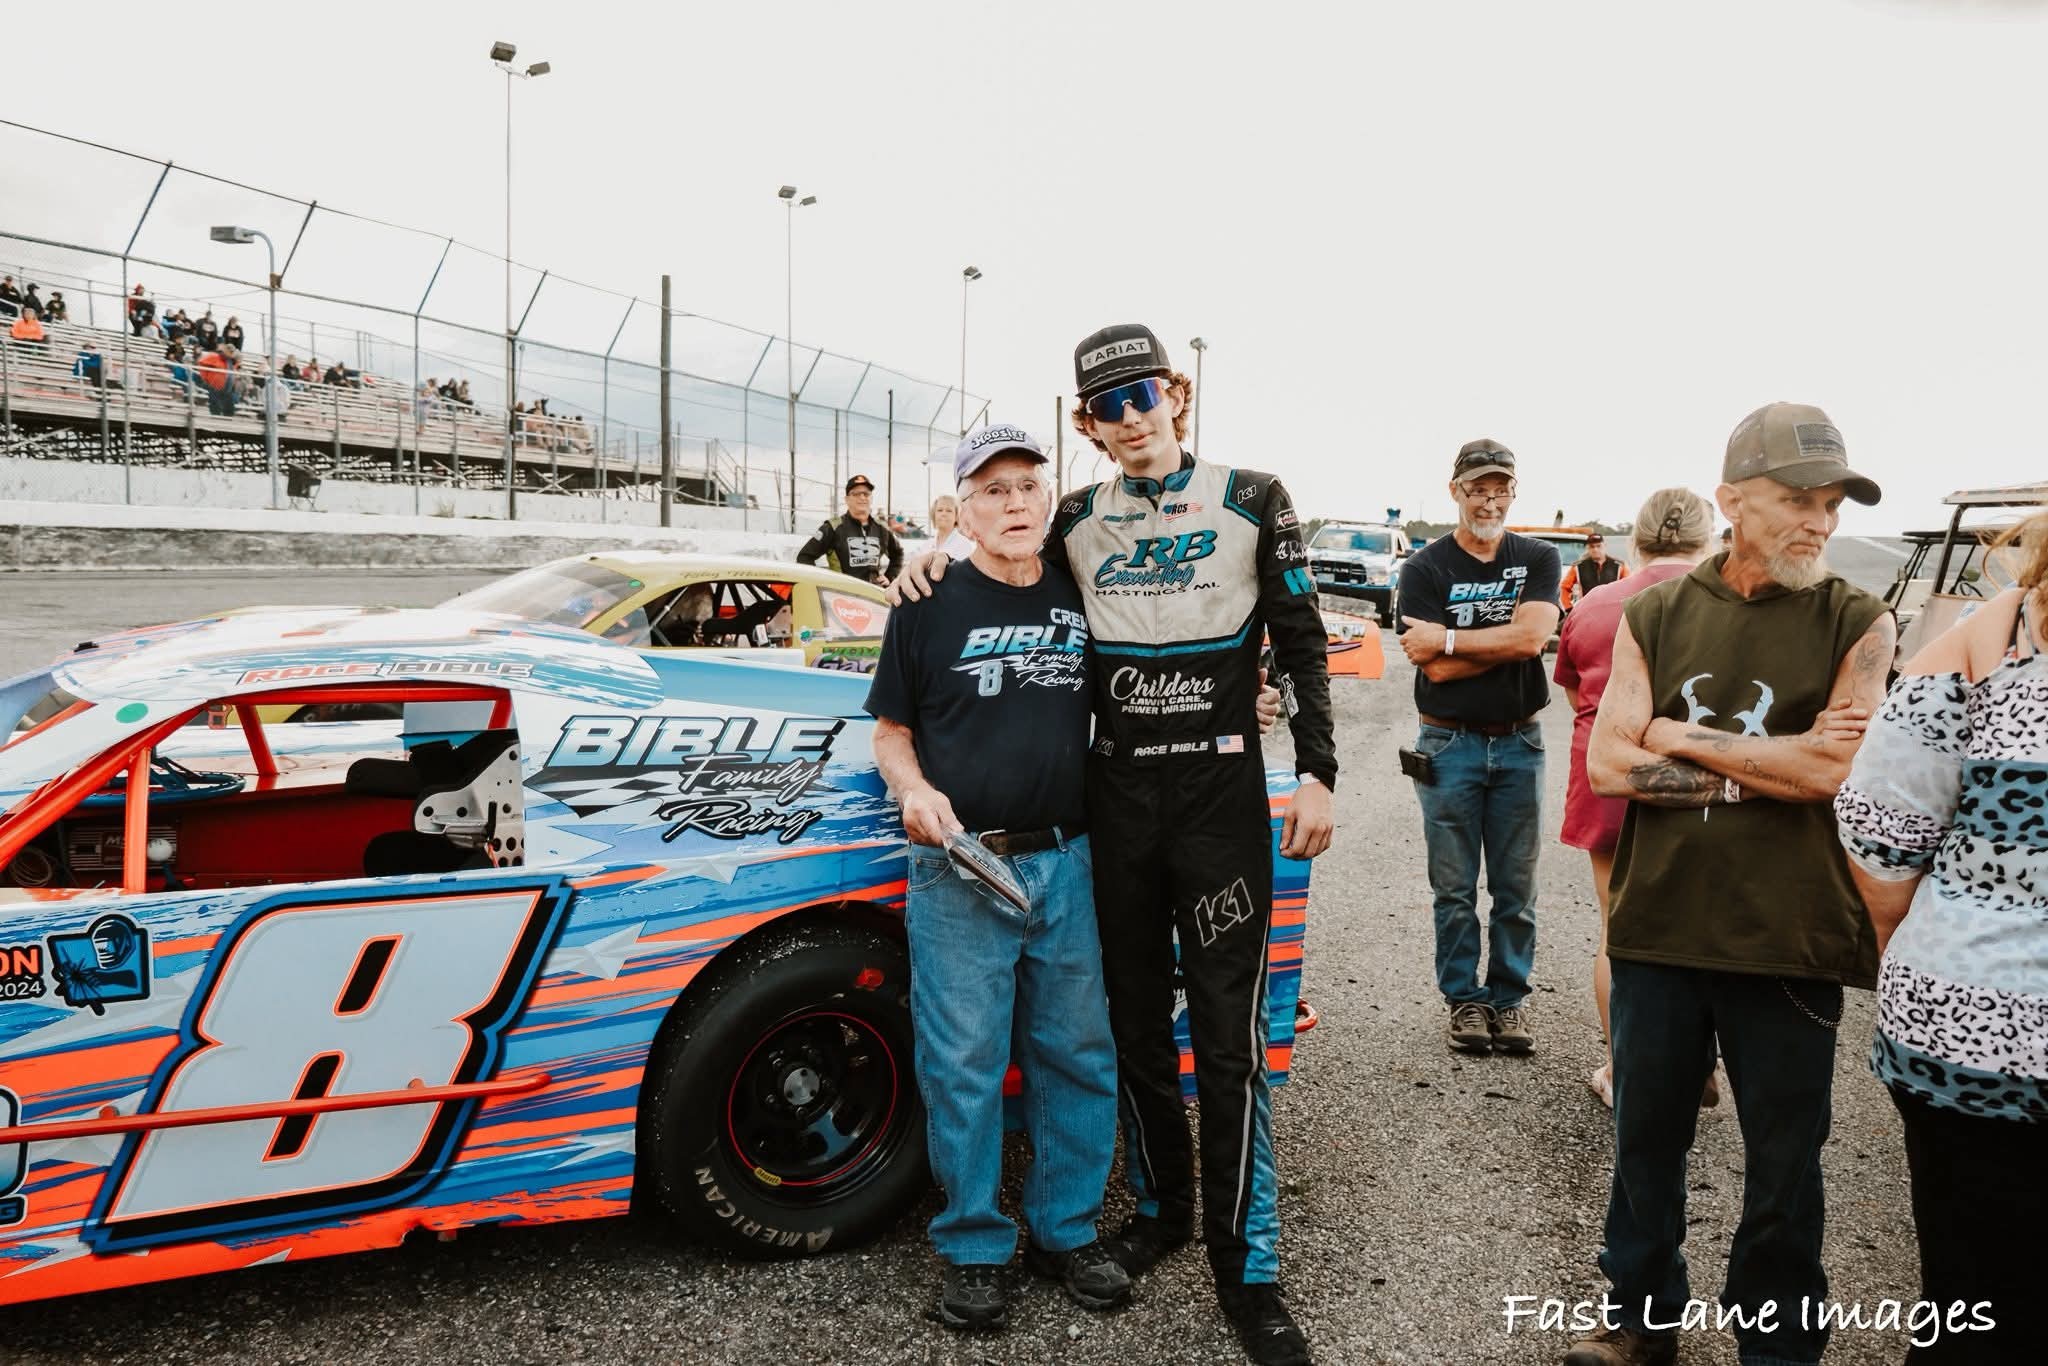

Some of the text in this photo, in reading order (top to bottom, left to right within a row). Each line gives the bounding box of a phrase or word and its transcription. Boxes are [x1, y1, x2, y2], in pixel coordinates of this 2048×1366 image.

[1095, 342, 1145, 362] ARIAT
[971, 427, 1026, 450] Hoosier
[1124, 529, 1218, 568] RB
[1095, 586, 1187, 597] HASTINGS
[960, 625, 1089, 659] BIBLE
[1022, 645, 1084, 673] Family
[239, 662, 533, 686] RACE BIBLE
[978, 660, 1004, 697] 8
[1015, 668, 1085, 692] Racing
[1110, 665, 1215, 701] Childers
[1121, 702, 1213, 715] POWER WASHING
[1130, 697, 1166, 707] LAWN
[547, 714, 847, 768] BIBLE
[1134, 741, 1209, 757] RACE BIBLE
[678, 752, 824, 806] Family
[661, 798, 823, 844] Racing
[1194, 876, 1255, 948] K1
[100, 885, 560, 1245] 8
[695, 1166, 834, 1253] AMERICAN
